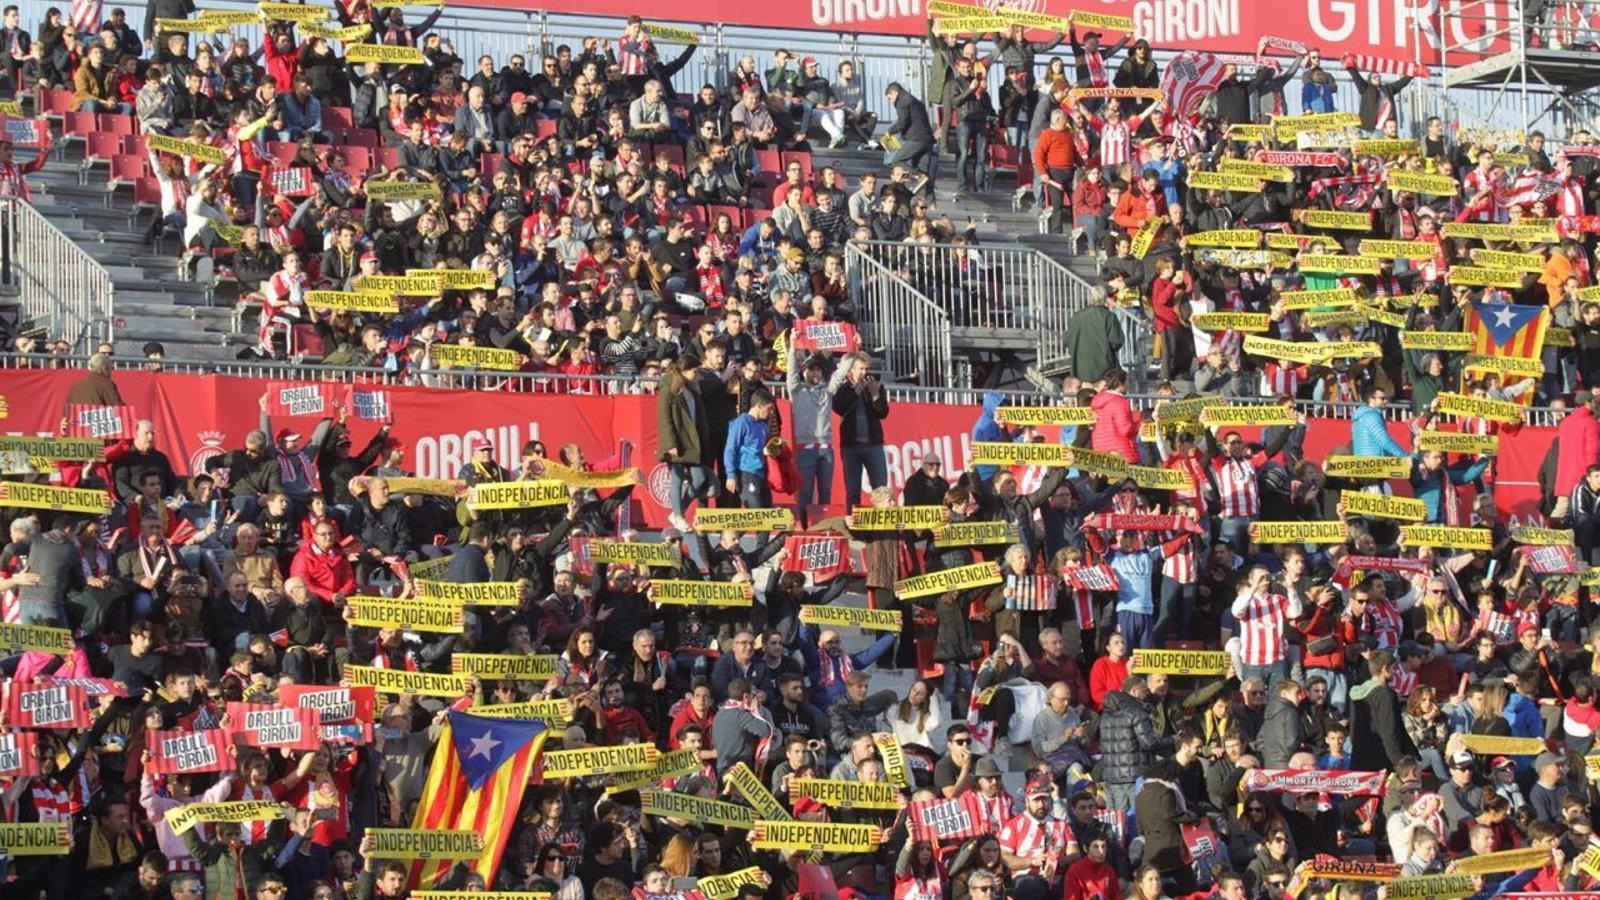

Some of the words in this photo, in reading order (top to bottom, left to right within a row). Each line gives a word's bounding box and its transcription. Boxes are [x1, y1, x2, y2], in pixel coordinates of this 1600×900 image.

[1133, 0, 1239, 43] GIRONI
[1268, 153, 1312, 165] GIRONA
[1314, 154, 1330, 164] FC
[1245, 341, 1325, 356] INDEPENDENCE
[281, 386, 318, 404] ORGULL
[291, 399, 323, 415] GIRONI
[1420, 435, 1493, 446] INDEPENDENCE
[1326, 458, 1403, 471] INDEPENDENCE
[697, 510, 786, 526] INDEPENDENCE
[726, 520, 764, 529] FREEDOM
[800, 541, 835, 558] ORGULL
[808, 552, 839, 570] GIRONI
[21, 689, 64, 711] ORGULL
[300, 690, 349, 709] ORGULL
[34, 704, 73, 724] GIRONI
[247, 708, 293, 729] ORGULL
[320, 703, 355, 723] IRONI
[259, 724, 300, 743] GIRONI
[163, 734, 207, 757] ORGULL
[177, 749, 216, 771] GIRONI
[211, 809, 261, 822] FREEDOM
